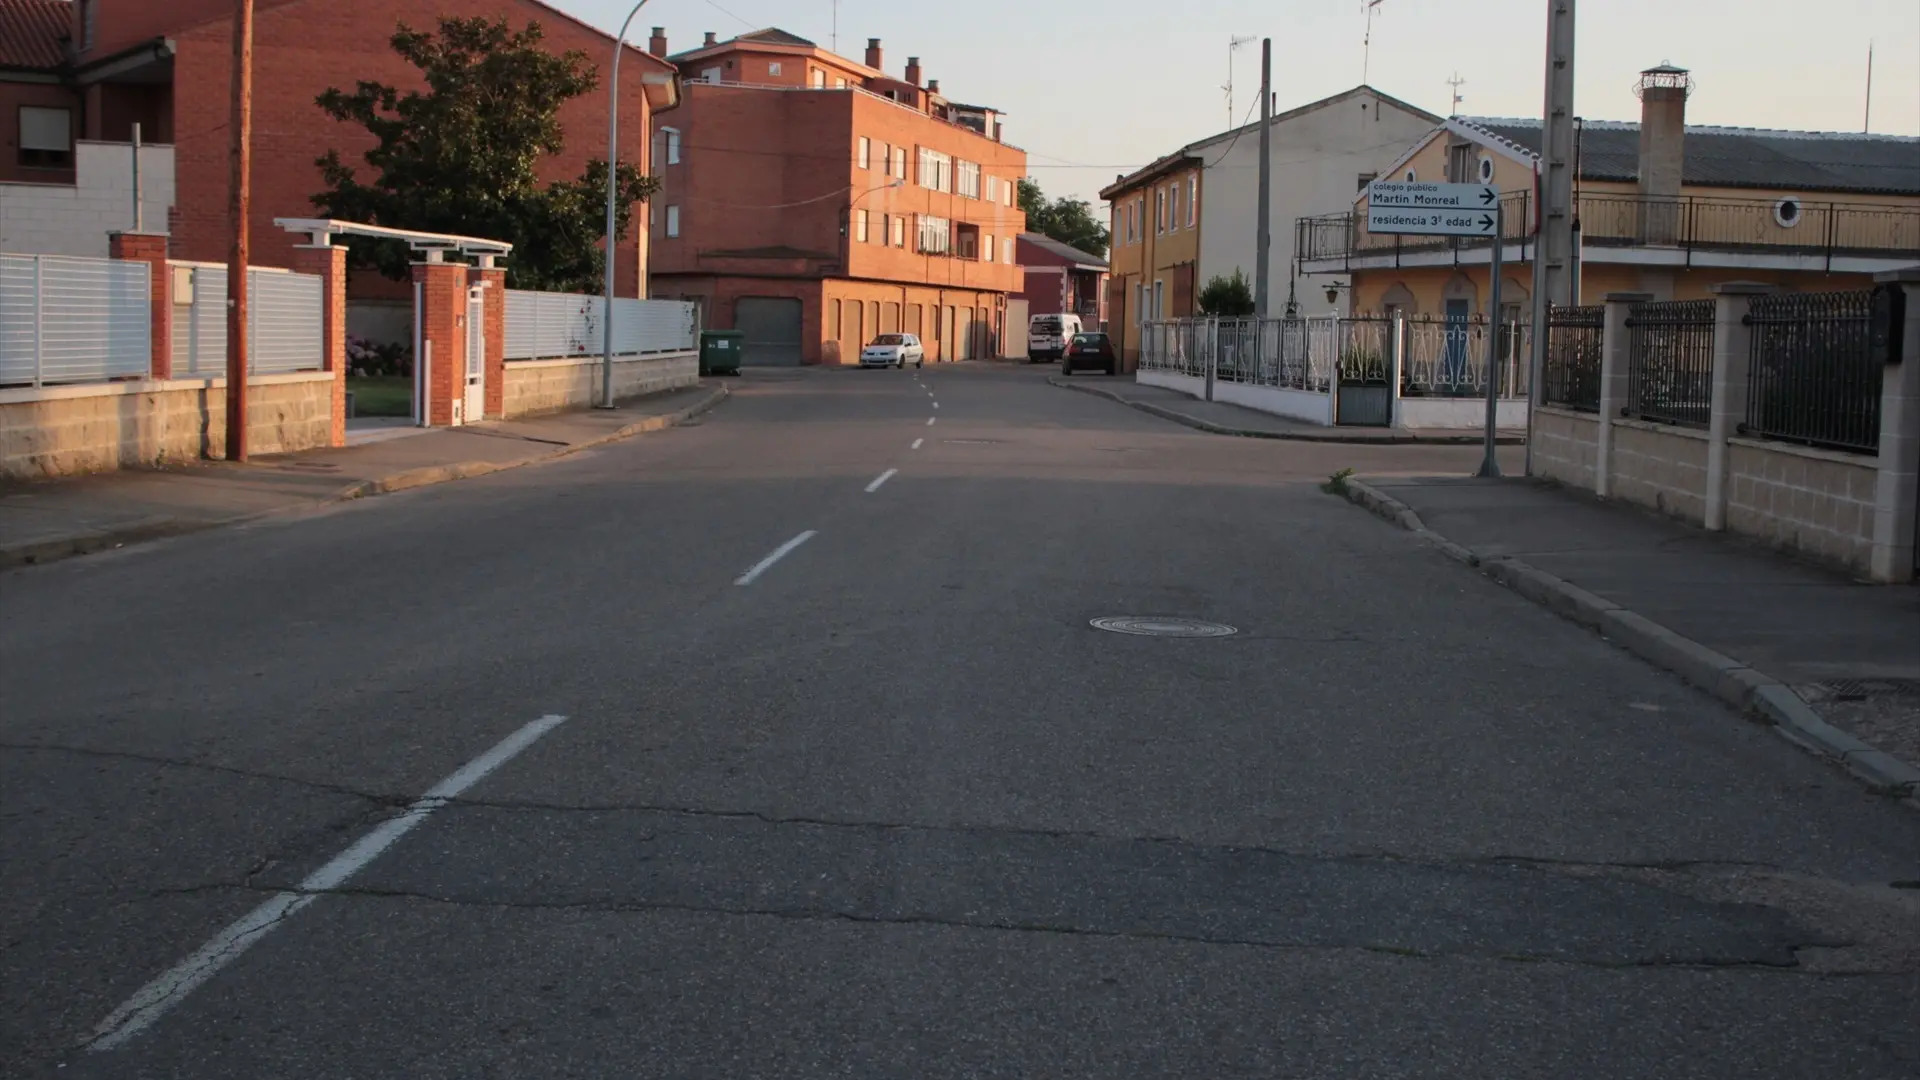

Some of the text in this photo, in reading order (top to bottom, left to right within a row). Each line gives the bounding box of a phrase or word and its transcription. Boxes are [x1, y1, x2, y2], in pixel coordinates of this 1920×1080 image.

[1374, 183, 1404, 192] colegio
[1414, 194, 1459, 205] Monreal
[1373, 215, 1426, 226] residencia
[1446, 216, 1472, 227] edad
